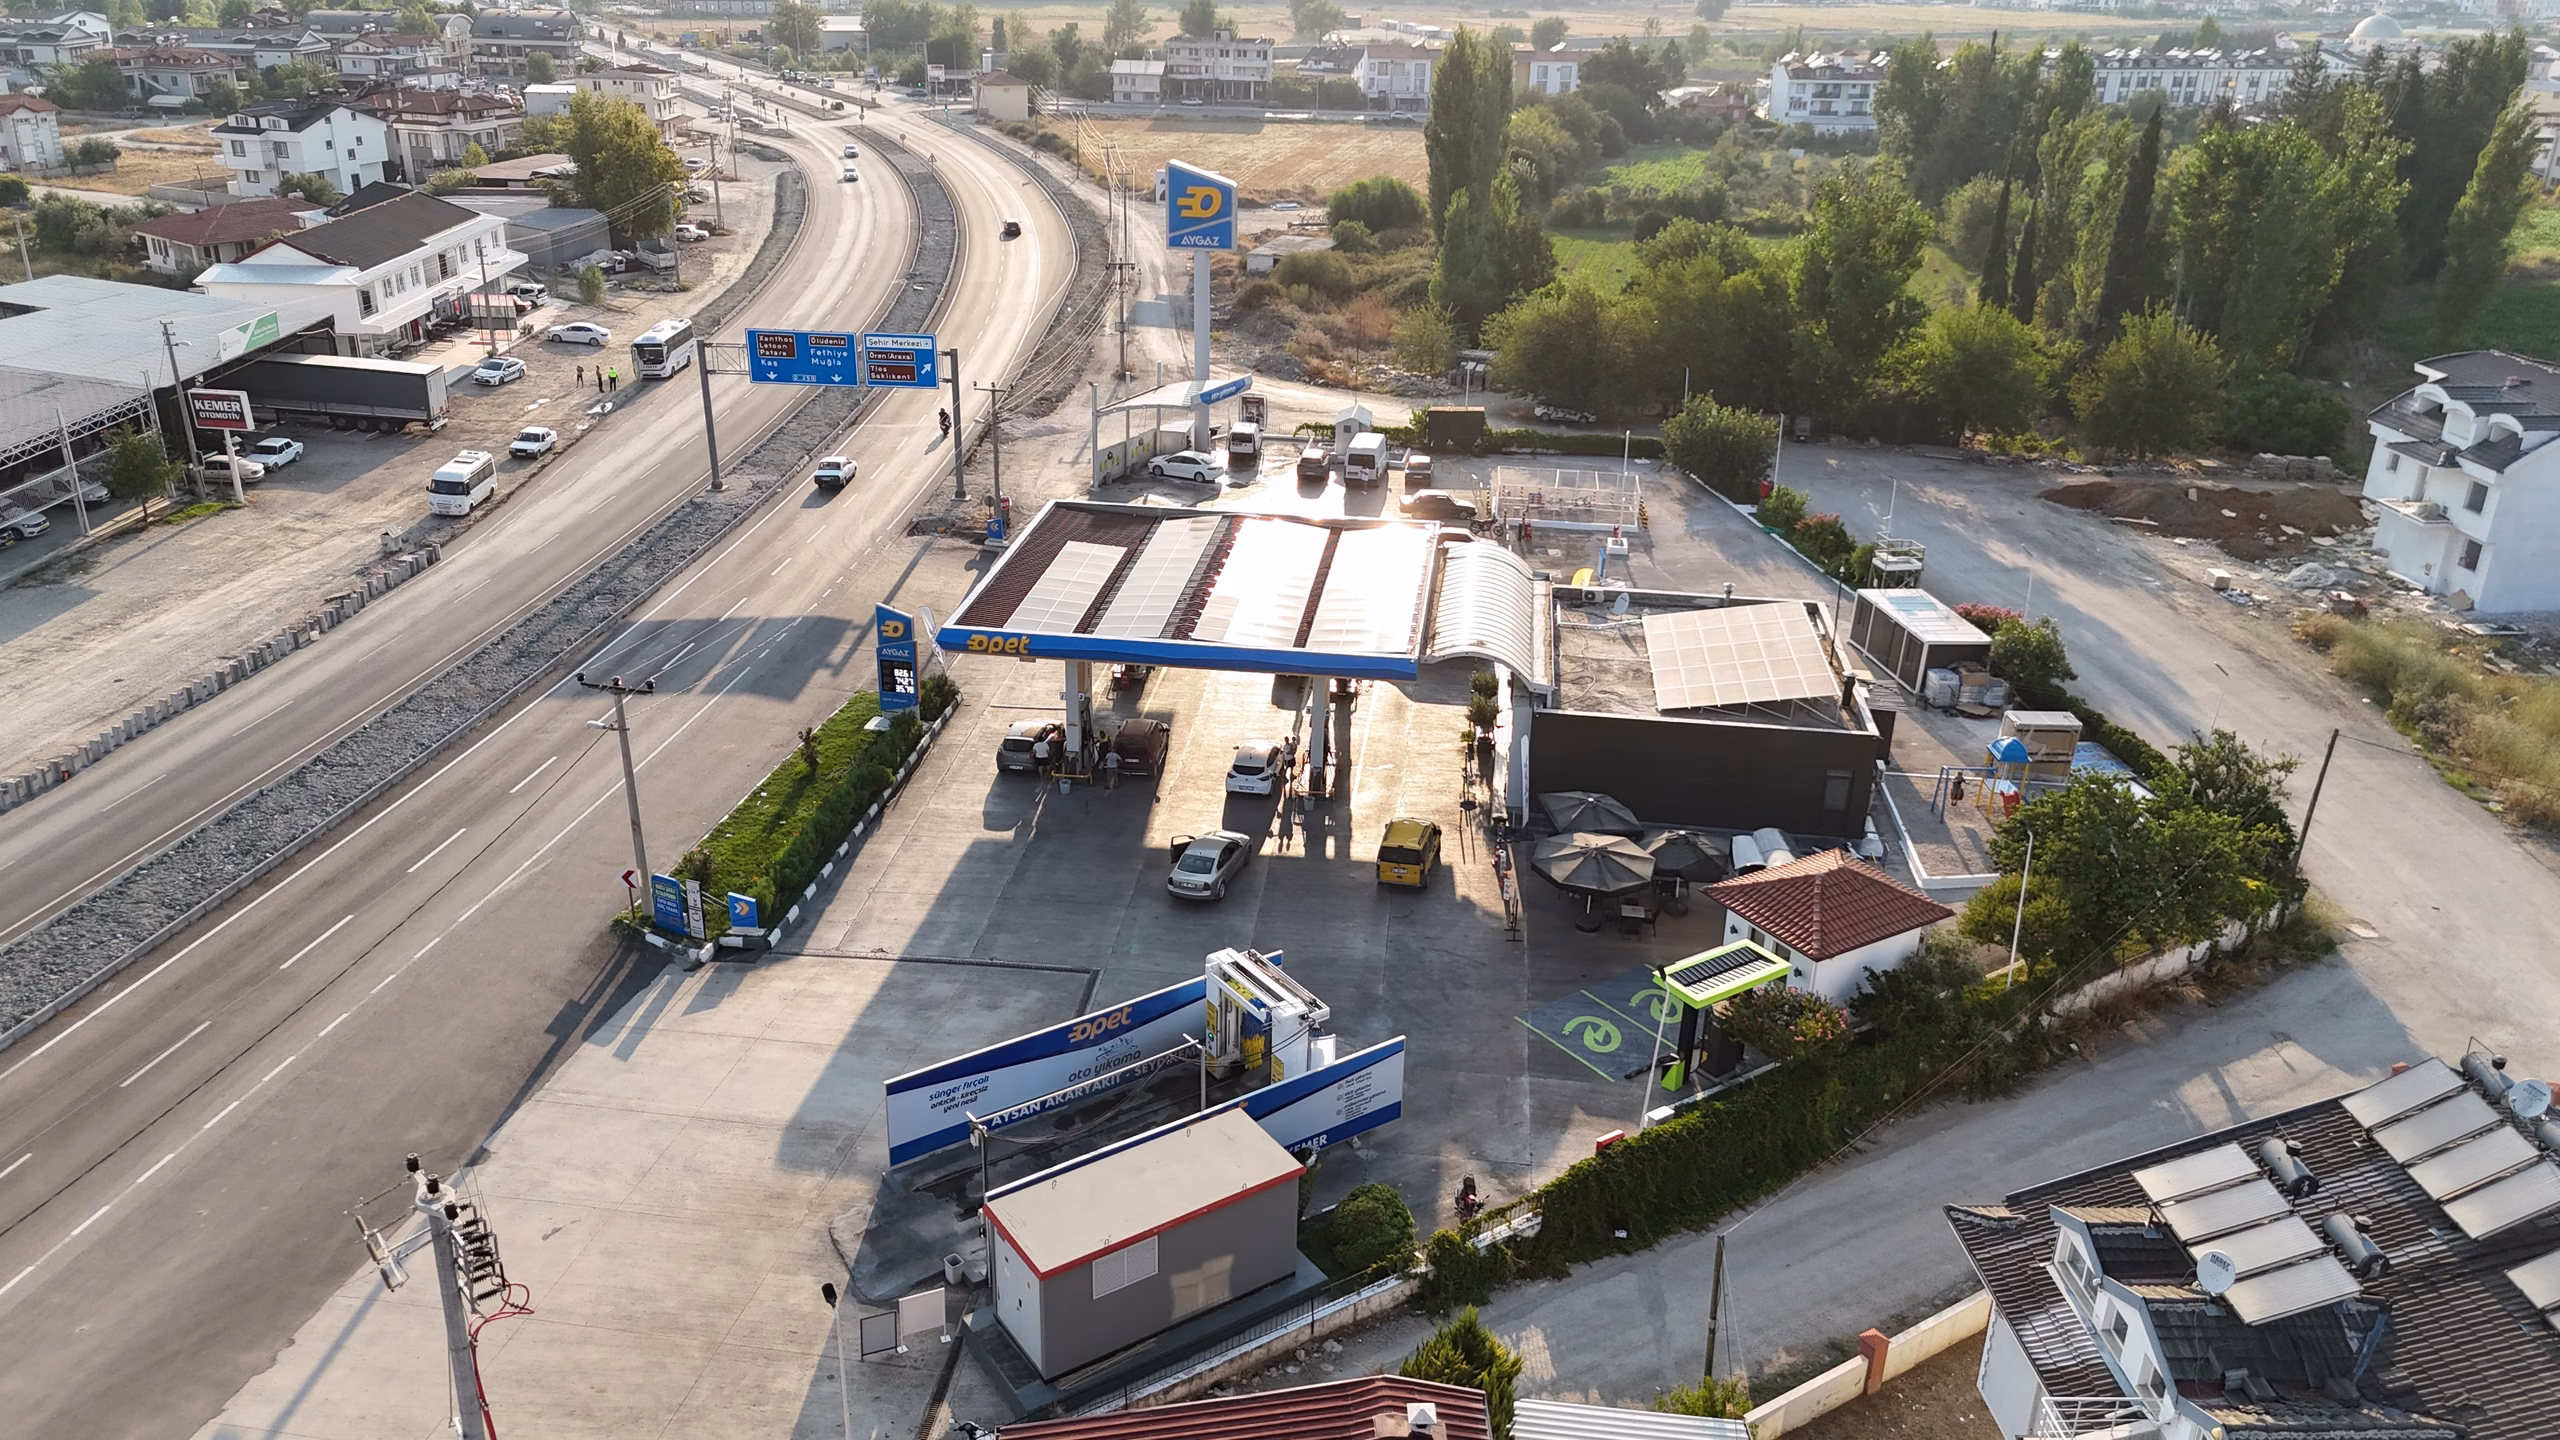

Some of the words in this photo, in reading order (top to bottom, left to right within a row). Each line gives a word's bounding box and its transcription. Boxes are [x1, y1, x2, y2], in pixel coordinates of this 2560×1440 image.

[1180, 234, 1220, 246] AYGAZ
[759, 335, 793, 343] Xanthos
[891, 339, 922, 348] Merkezi
[810, 348, 848, 358] Fethiye
[811, 357, 842, 367] Muğla
[870, 365, 888, 373] Tlos
[193, 399, 242, 412] KEMER
[199, 411, 240, 420] OTOMOTİV
[881, 647, 910, 657] AYGAZ
[1068, 1066, 1091, 1083] oto
[928, 1084, 962, 1101] sünger
[991, 1104, 1041, 1127] AYSAN
[1045, 1072, 1122, 1108] AKARYAKIT
